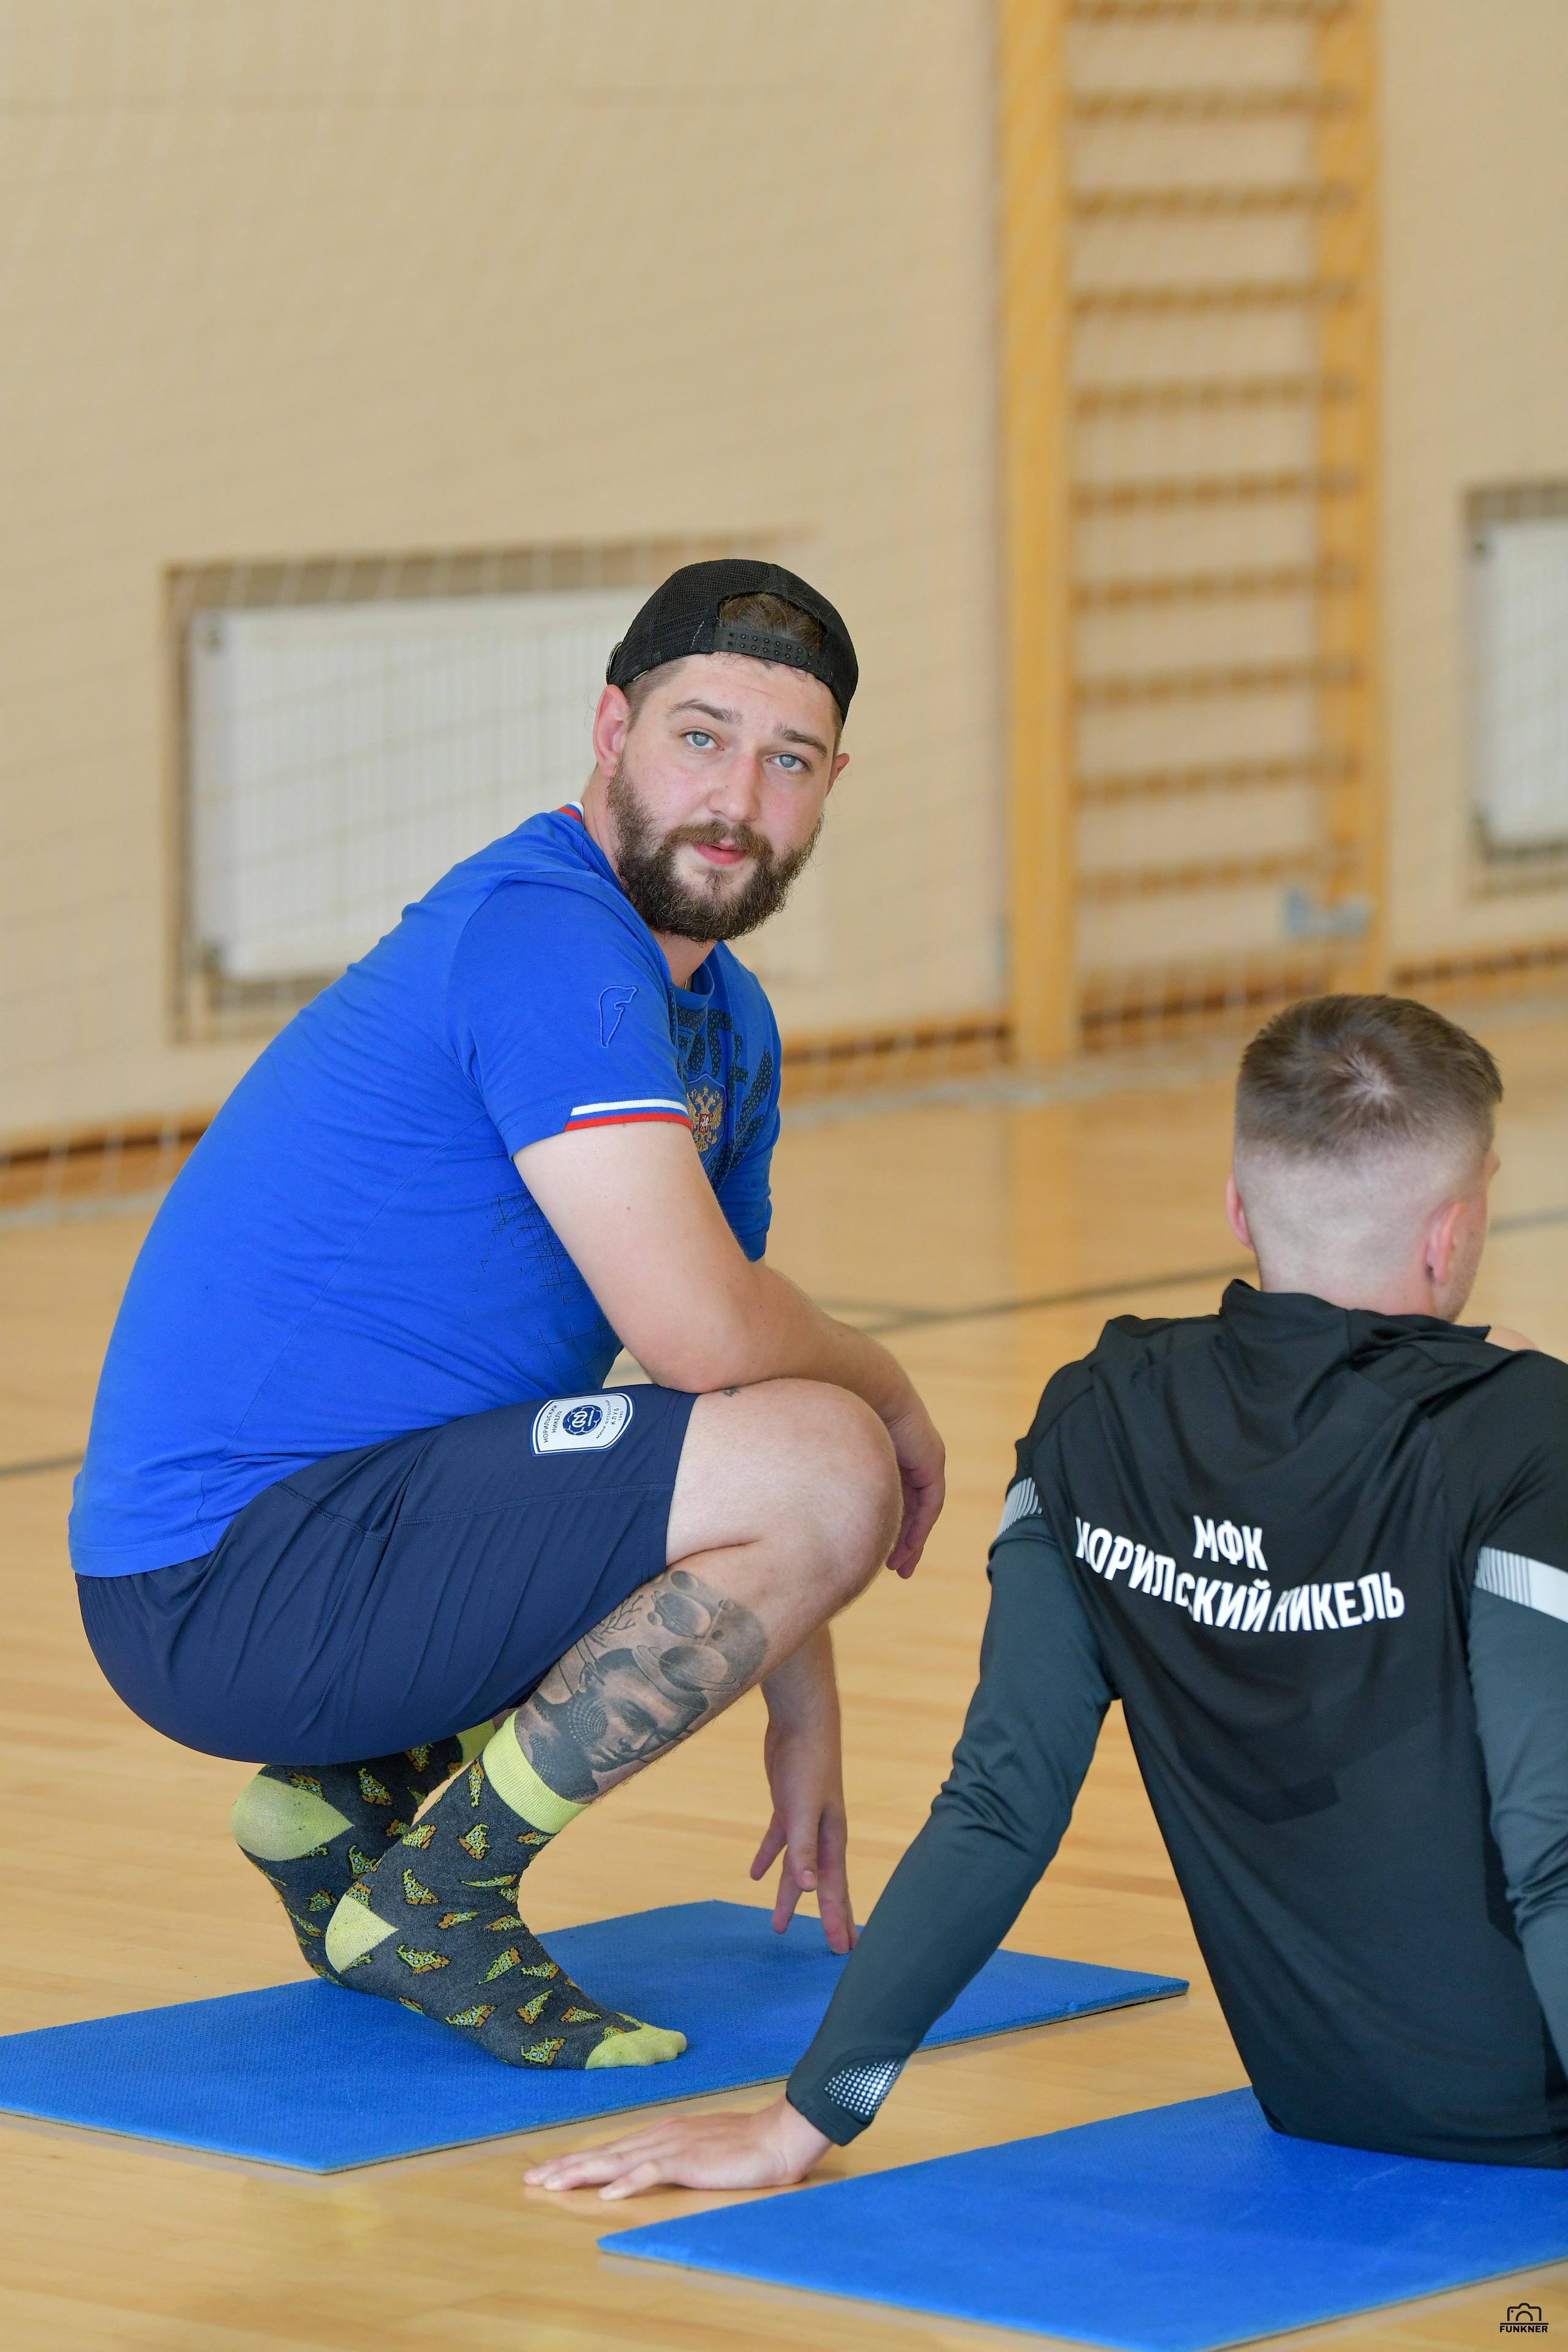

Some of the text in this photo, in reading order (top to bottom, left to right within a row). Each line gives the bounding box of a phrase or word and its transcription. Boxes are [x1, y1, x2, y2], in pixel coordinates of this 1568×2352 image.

[543, 1404, 559, 1444] НОРИЛЬСКИЙ
[551, 1411, 562, 1433] НИКЕЛЬ
[611, 1408, 619, 1425] КЛУБ
[1193, 1515, 1268, 1572] МФК
[1268, 1571, 1406, 1632] НИКЕЛЬ
